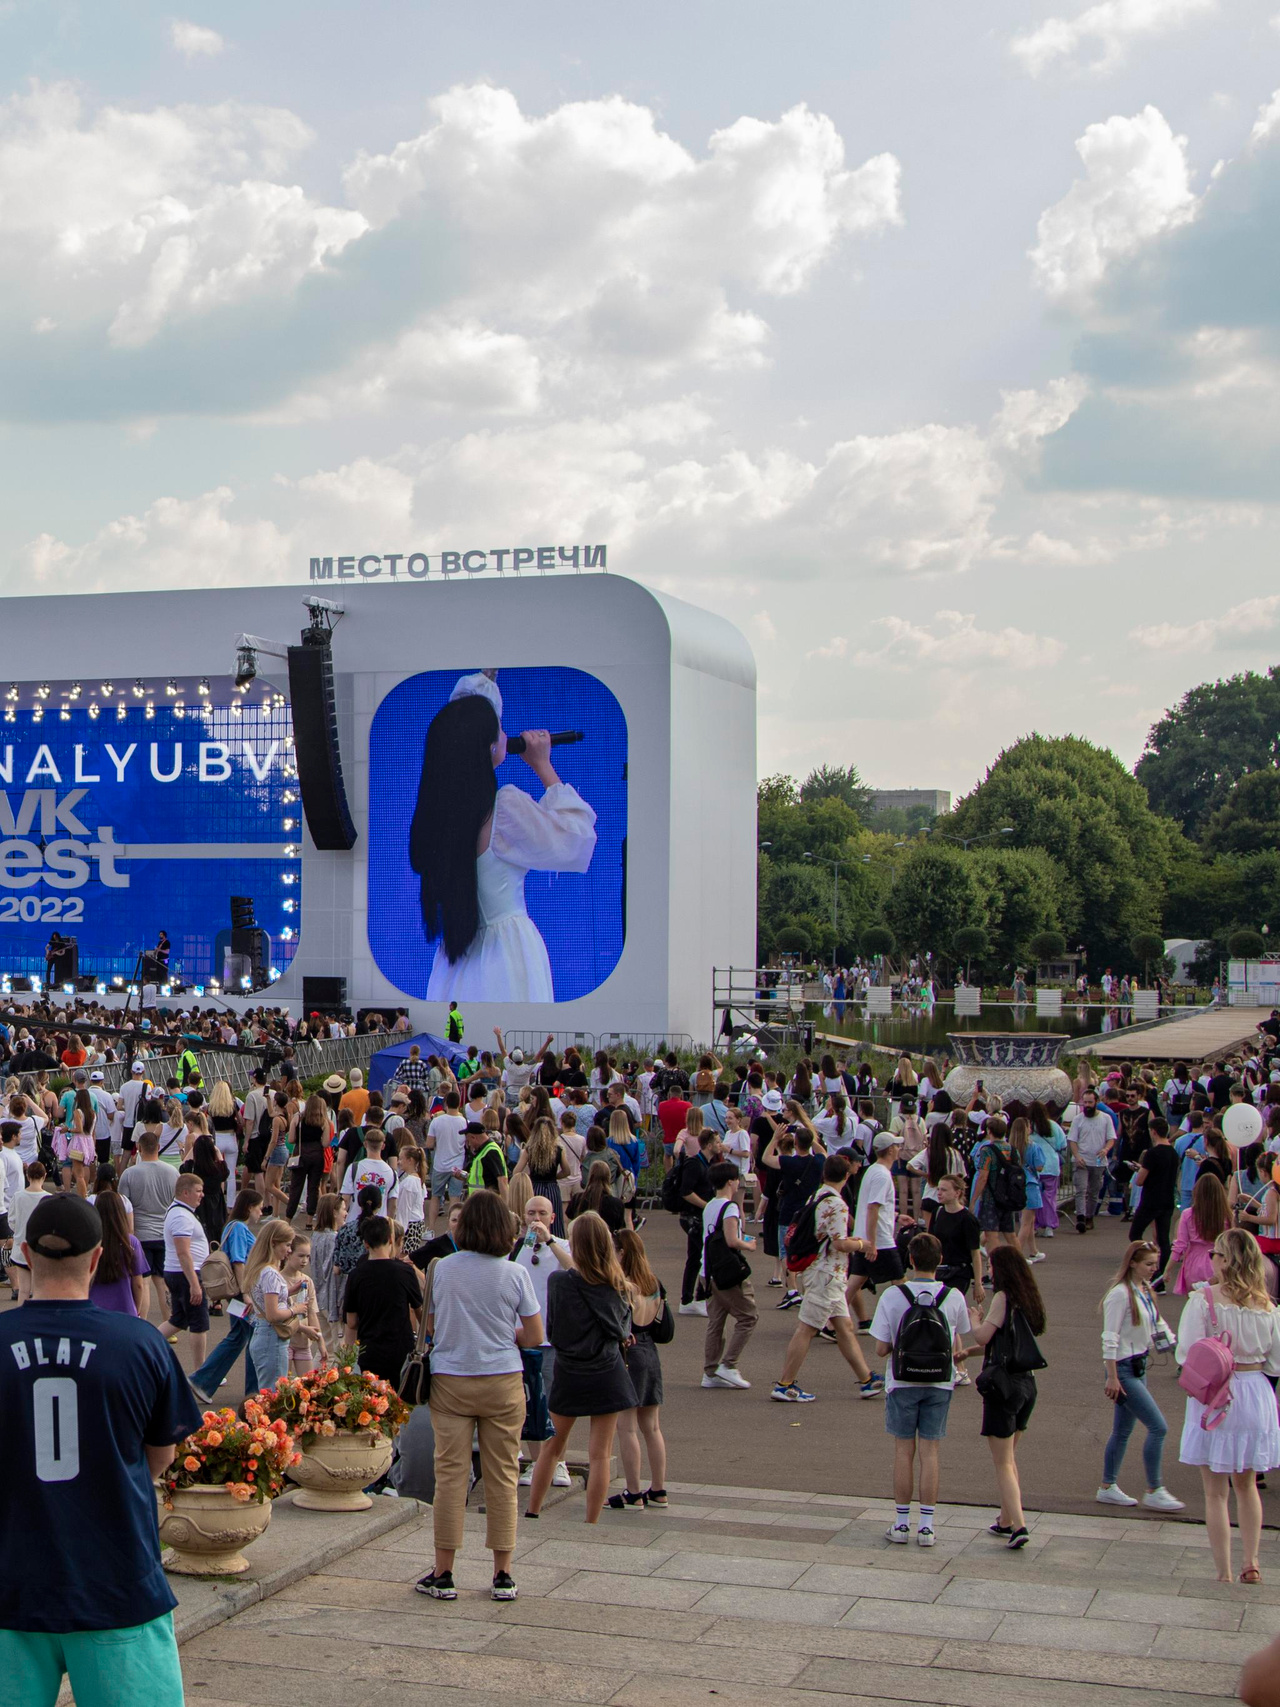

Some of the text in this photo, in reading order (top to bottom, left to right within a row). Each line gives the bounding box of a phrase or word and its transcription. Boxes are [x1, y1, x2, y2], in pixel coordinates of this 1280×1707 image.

[309, 545, 607, 580] МЕСТО ВСТРЕЧИ
[10, 1337, 97, 1370] BLAT
[33, 1377, 80, 1482] 0
